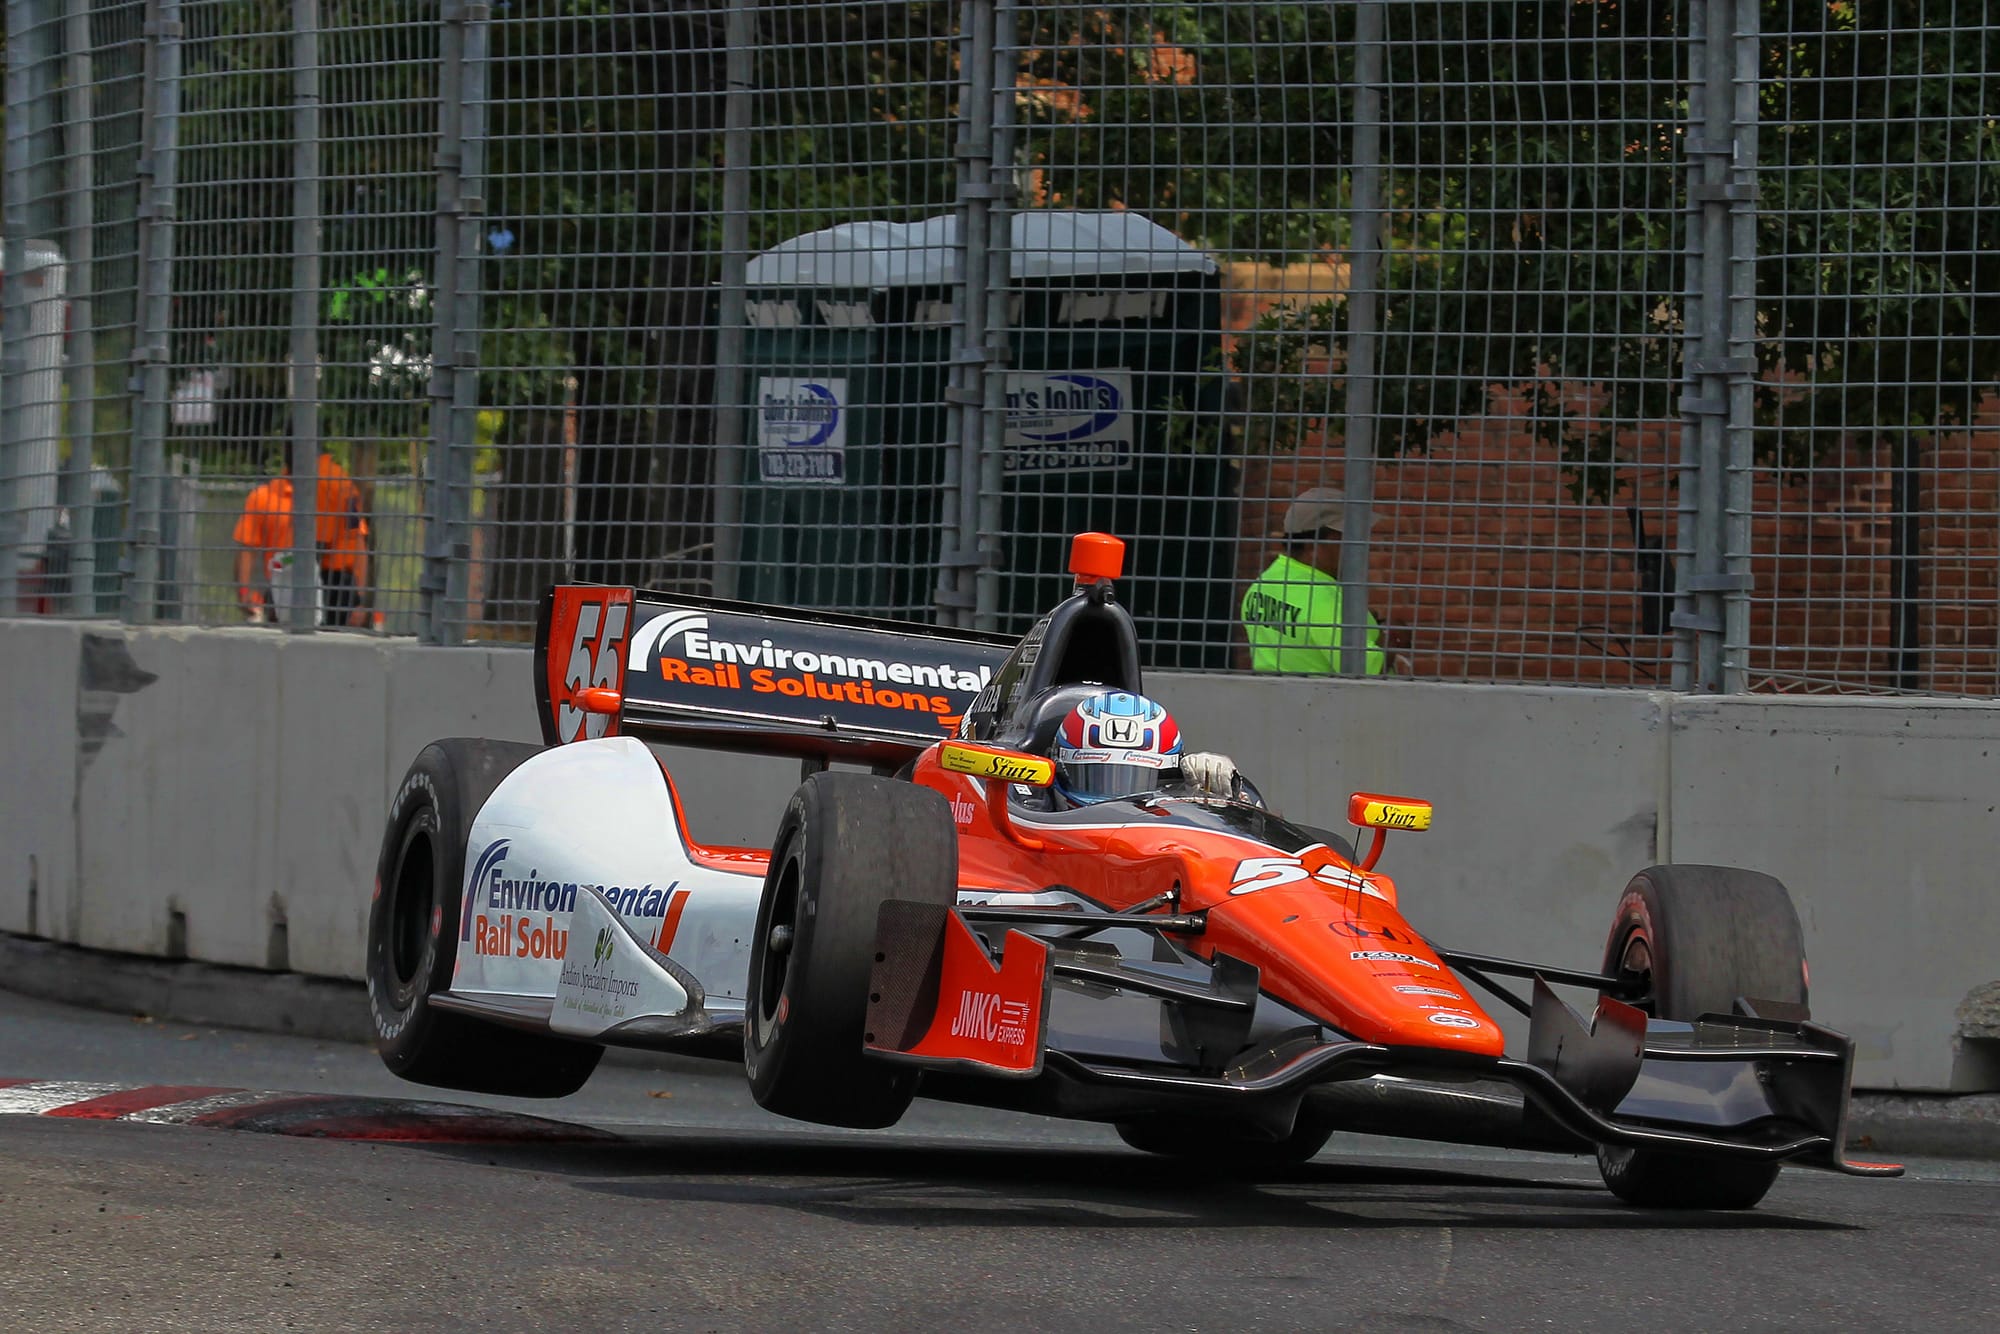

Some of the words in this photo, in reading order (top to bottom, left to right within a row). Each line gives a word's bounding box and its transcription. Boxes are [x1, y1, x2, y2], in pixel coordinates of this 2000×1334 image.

[1006, 388, 1039, 416] n's
[559, 601, 628, 744] 55
[684, 631, 992, 693] Environmental
[660, 657, 740, 689] Rail
[752, 668, 952, 714] Solutions
[986, 757, 1039, 782] Stutz
[1375, 805, 1416, 828] Stutz
[475, 915, 512, 956] Rail
[607, 970, 639, 1001] Imports
[951, 991, 1000, 1041] JMKC
[997, 1026, 1025, 1046] EXPRESS
